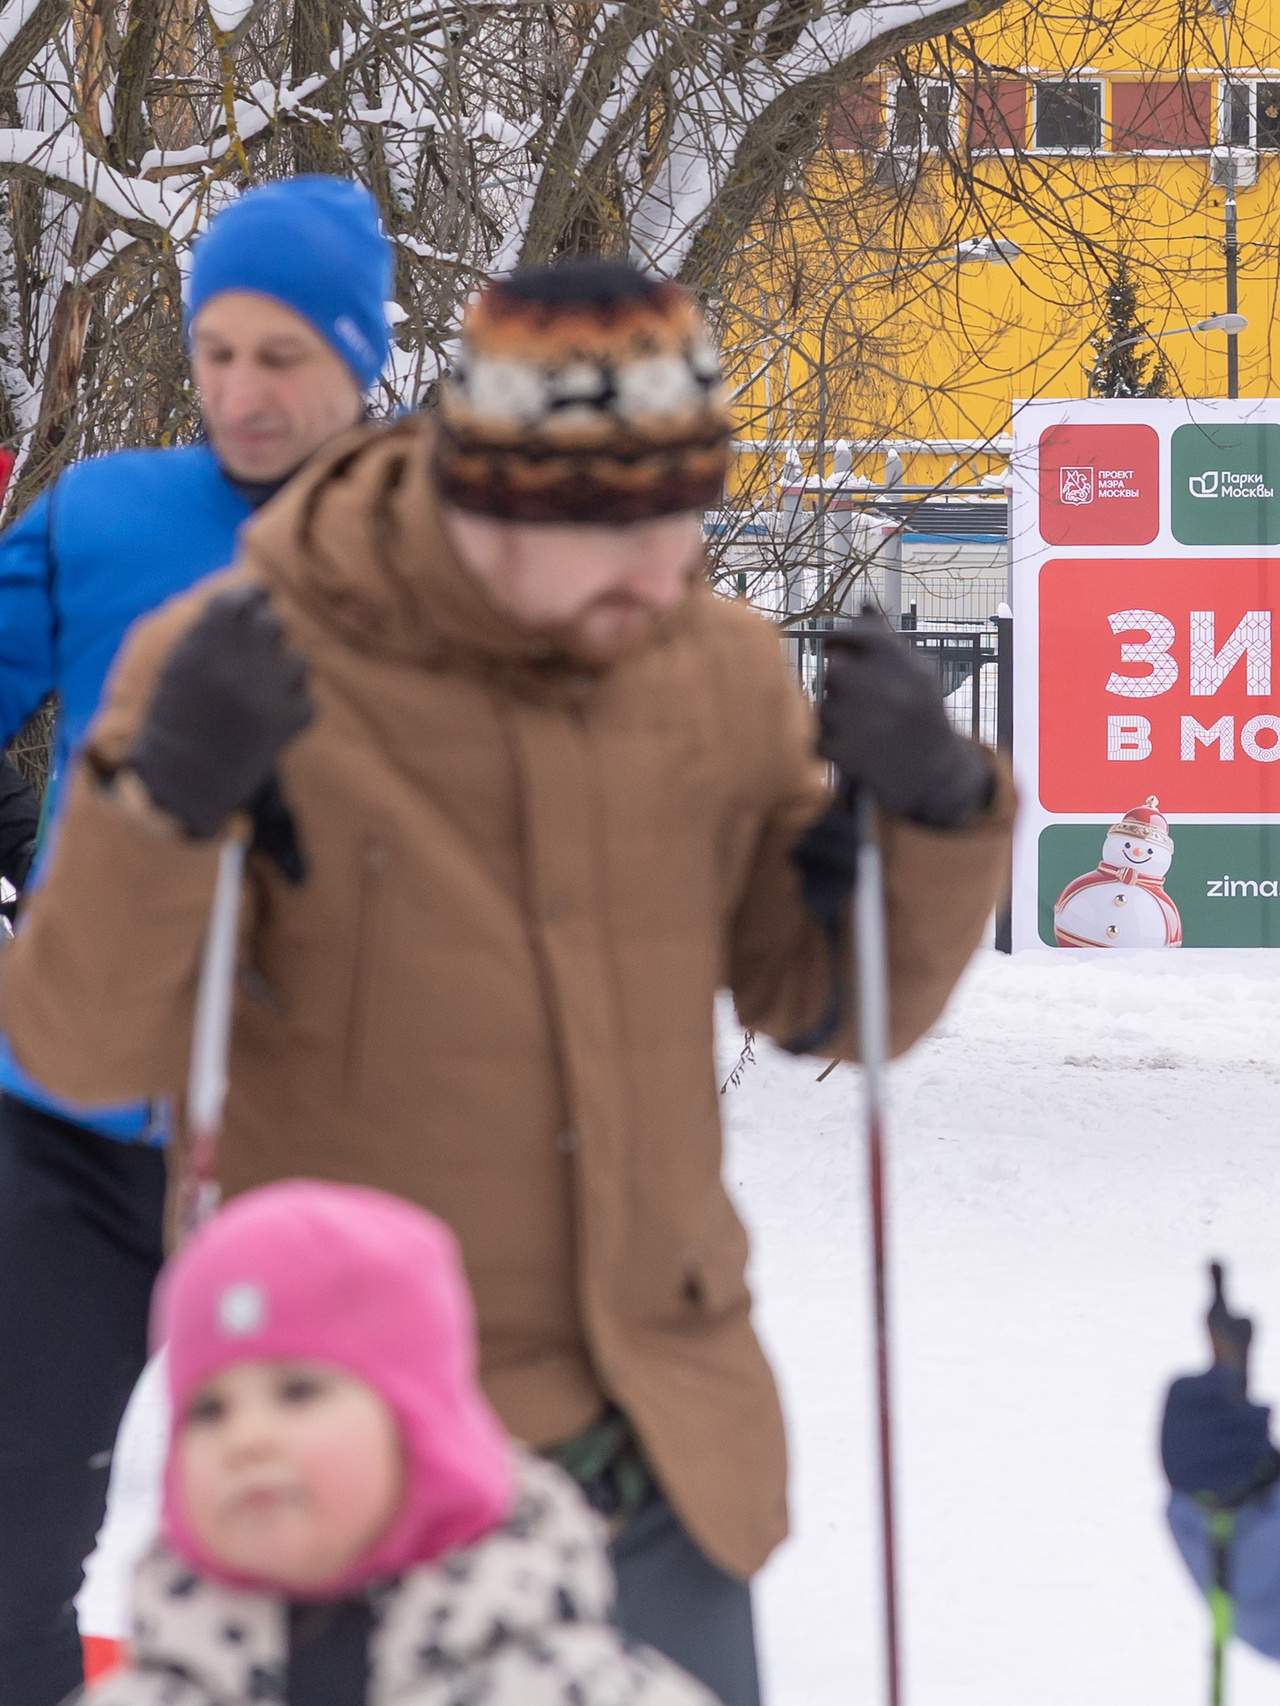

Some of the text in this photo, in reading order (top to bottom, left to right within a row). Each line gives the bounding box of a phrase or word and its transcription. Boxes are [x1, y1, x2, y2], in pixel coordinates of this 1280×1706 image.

[1098, 470, 1134, 479] ПРОЕКТ
[1221, 471, 1263, 488] Парки
[1098, 480, 1125, 488] МЭРА
[1098, 489, 1139, 498] МОСКВЫ
[1221, 484, 1274, 498] Москвы
[1107, 715, 1152, 761] В
